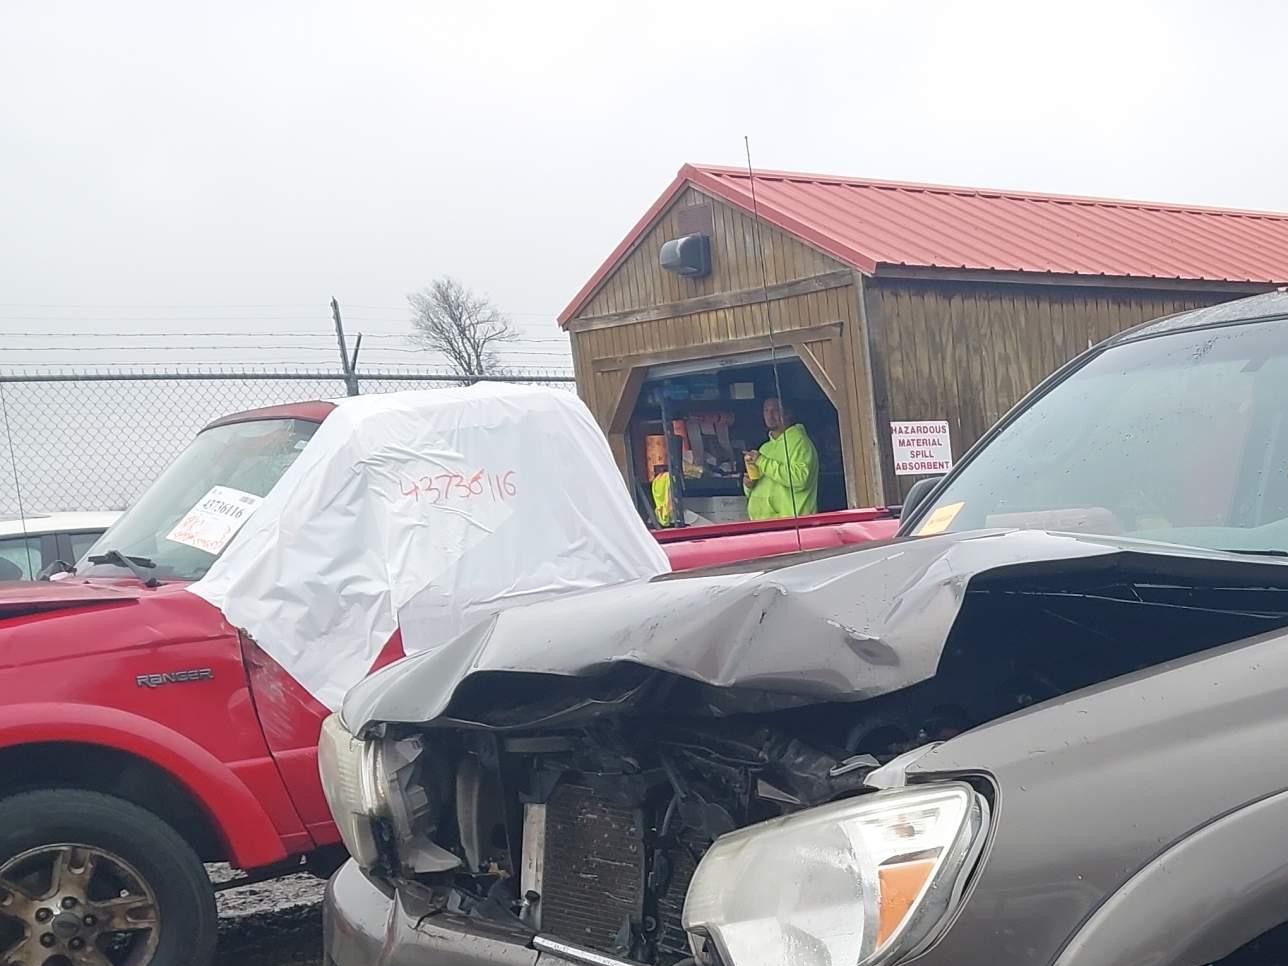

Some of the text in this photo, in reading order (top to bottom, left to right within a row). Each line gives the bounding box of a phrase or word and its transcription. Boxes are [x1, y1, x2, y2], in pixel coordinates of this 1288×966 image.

[890, 425, 947, 434] HAZARDOUS
[898, 438, 943, 447] MATERIAL
[910, 450, 934, 458] SPILL
[896, 461, 950, 471] ABSORBENT
[136, 667, 214, 687] RANGER
